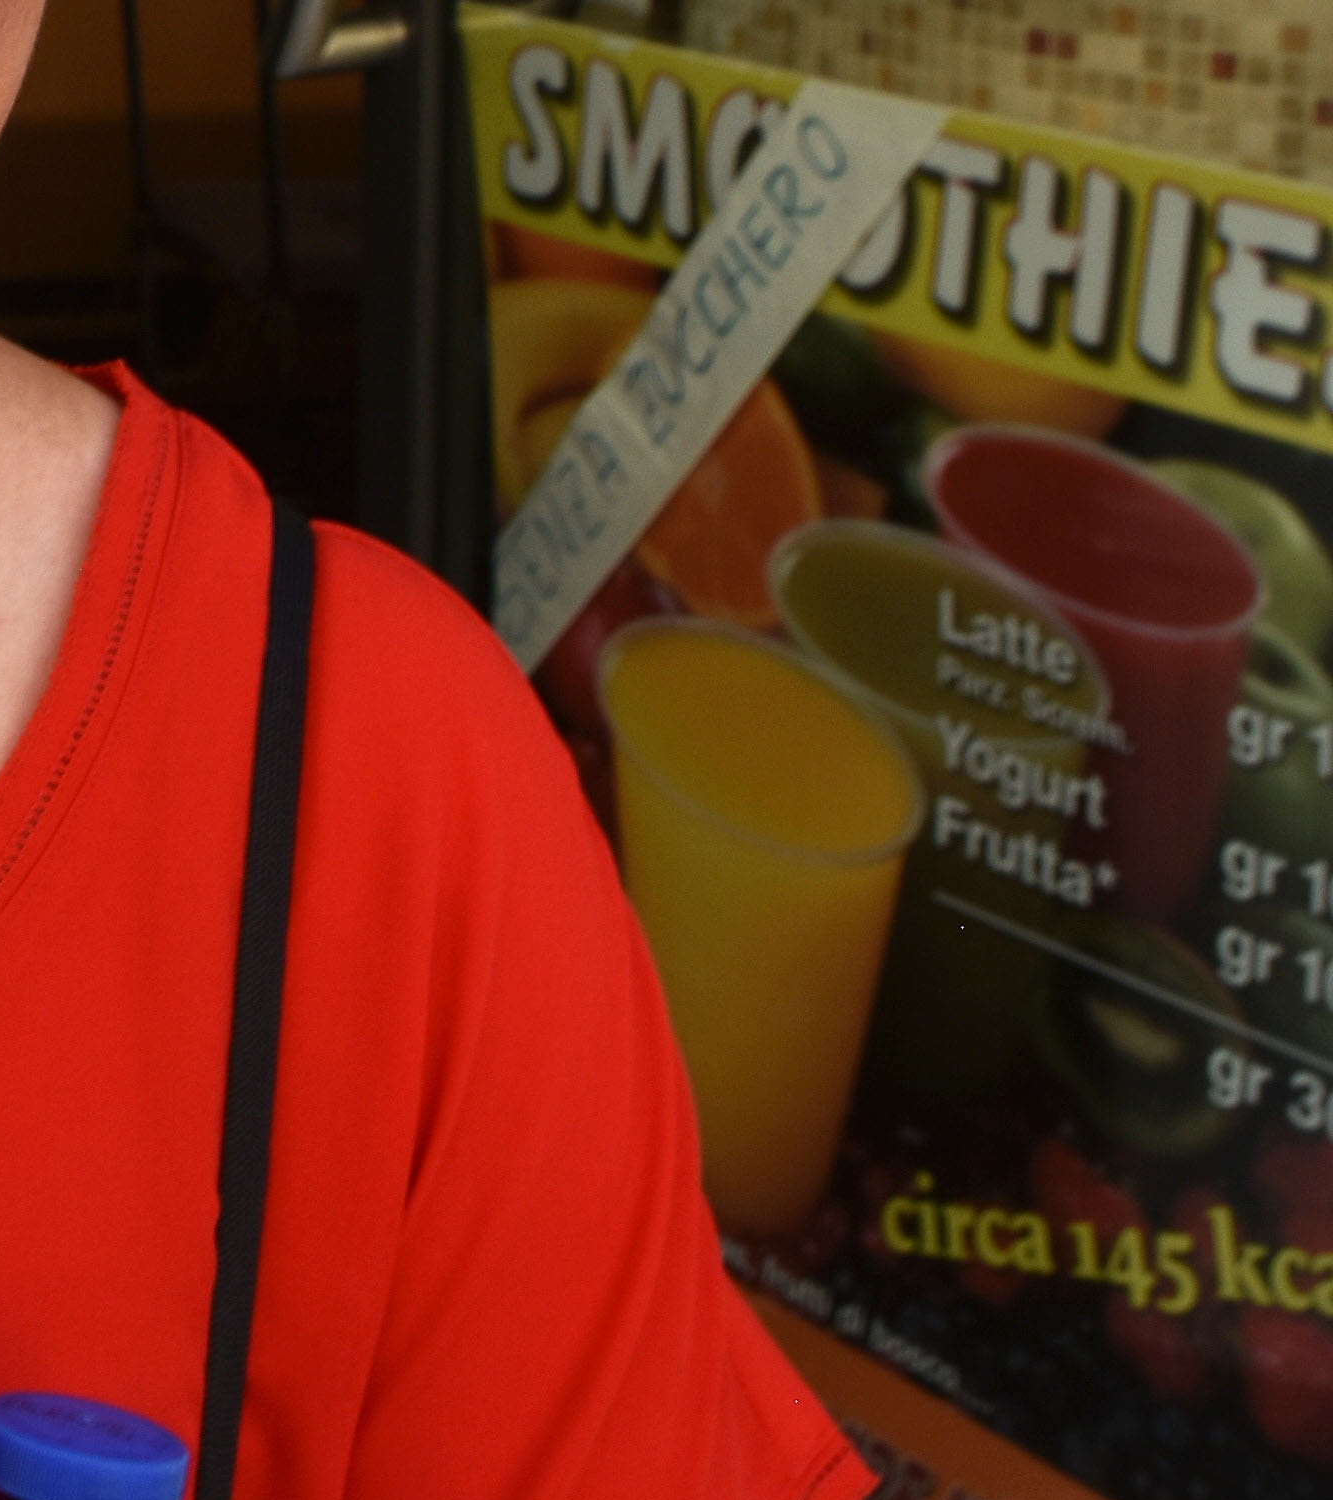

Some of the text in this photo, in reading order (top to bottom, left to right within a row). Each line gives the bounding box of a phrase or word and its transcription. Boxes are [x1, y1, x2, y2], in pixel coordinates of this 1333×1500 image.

[937, 590, 1078, 684] Latte
[934, 714, 1107, 829] Yogurt
[1225, 704, 1333, 779] gr 1
[1218, 839, 1333, 915] gr 1
[1214, 926, 1284, 988] gr
[1206, 1046, 1333, 1134] gr 3
[880, 1169, 1055, 1274] circa
[1071, 1222, 1199, 1316] 145
